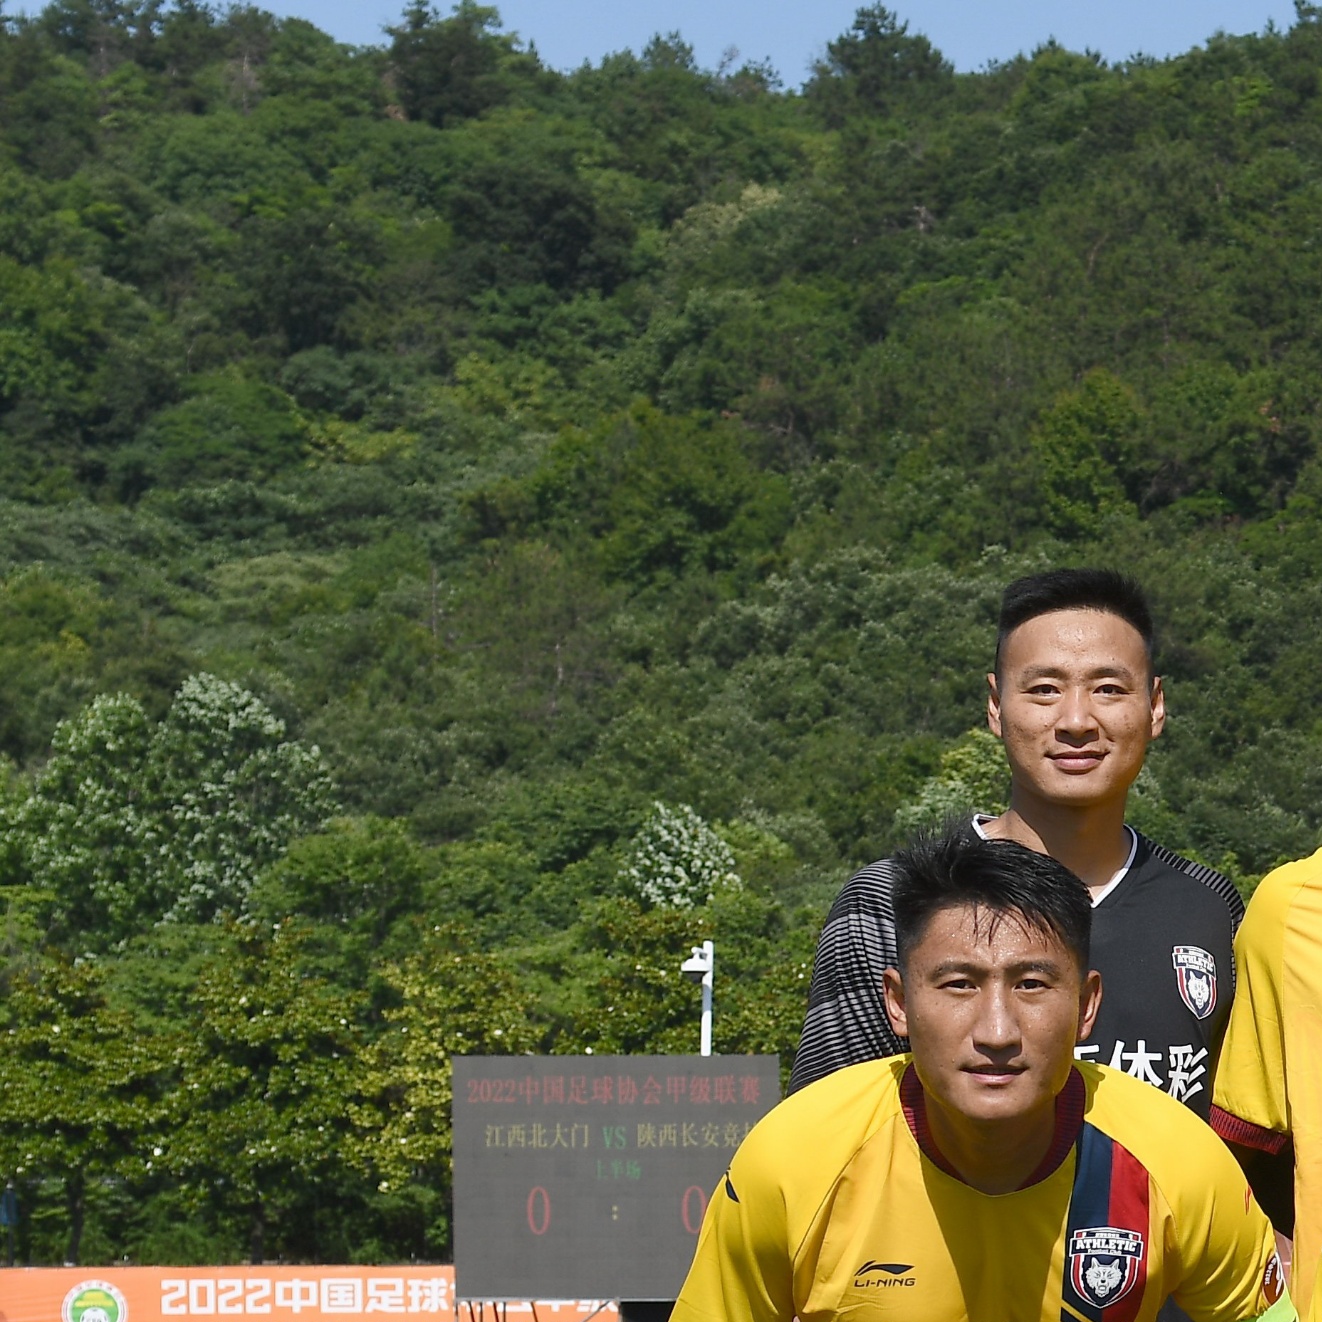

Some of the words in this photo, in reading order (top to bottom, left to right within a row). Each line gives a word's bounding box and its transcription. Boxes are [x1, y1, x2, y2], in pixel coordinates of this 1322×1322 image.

[1074, 1039, 1209, 1102] 体彩
[467, 1075, 761, 1105] 2022中国足球协会甲级联赛
[485, 1123, 589, 1148] 江西北大门
[603, 1126, 626, 1149] VS
[527, 1185, 550, 1235] 0
[681, 1185, 706, 1235] 0
[1076, 1238, 1137, 1252] ATHLETIC
[854, 1277, 916, 1289] LI-NING
